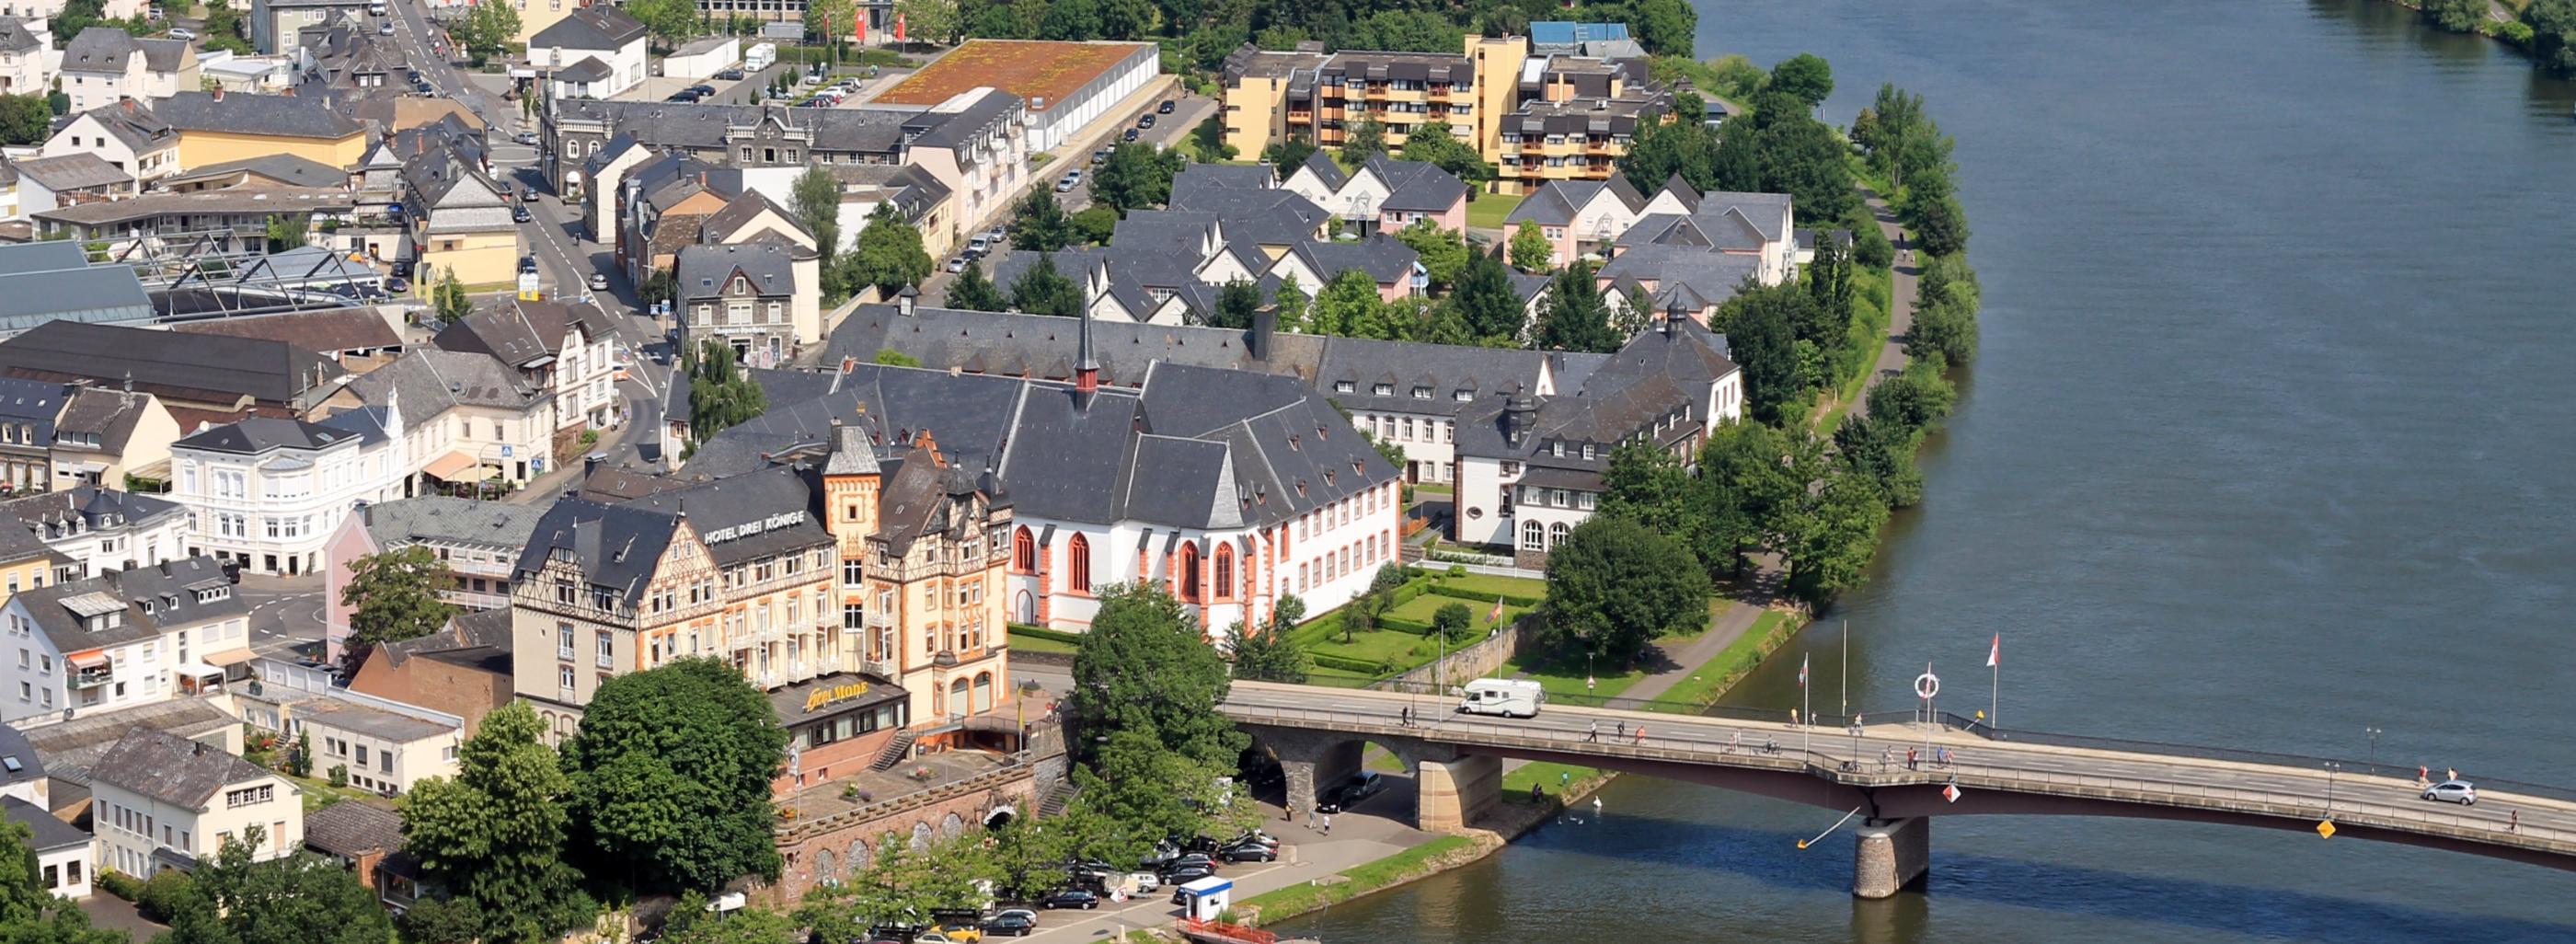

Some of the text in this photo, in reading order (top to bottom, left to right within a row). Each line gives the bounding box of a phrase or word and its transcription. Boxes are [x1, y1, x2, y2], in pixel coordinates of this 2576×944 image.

[705, 510, 804, 544] HOTEL DREI KÖNIGE
